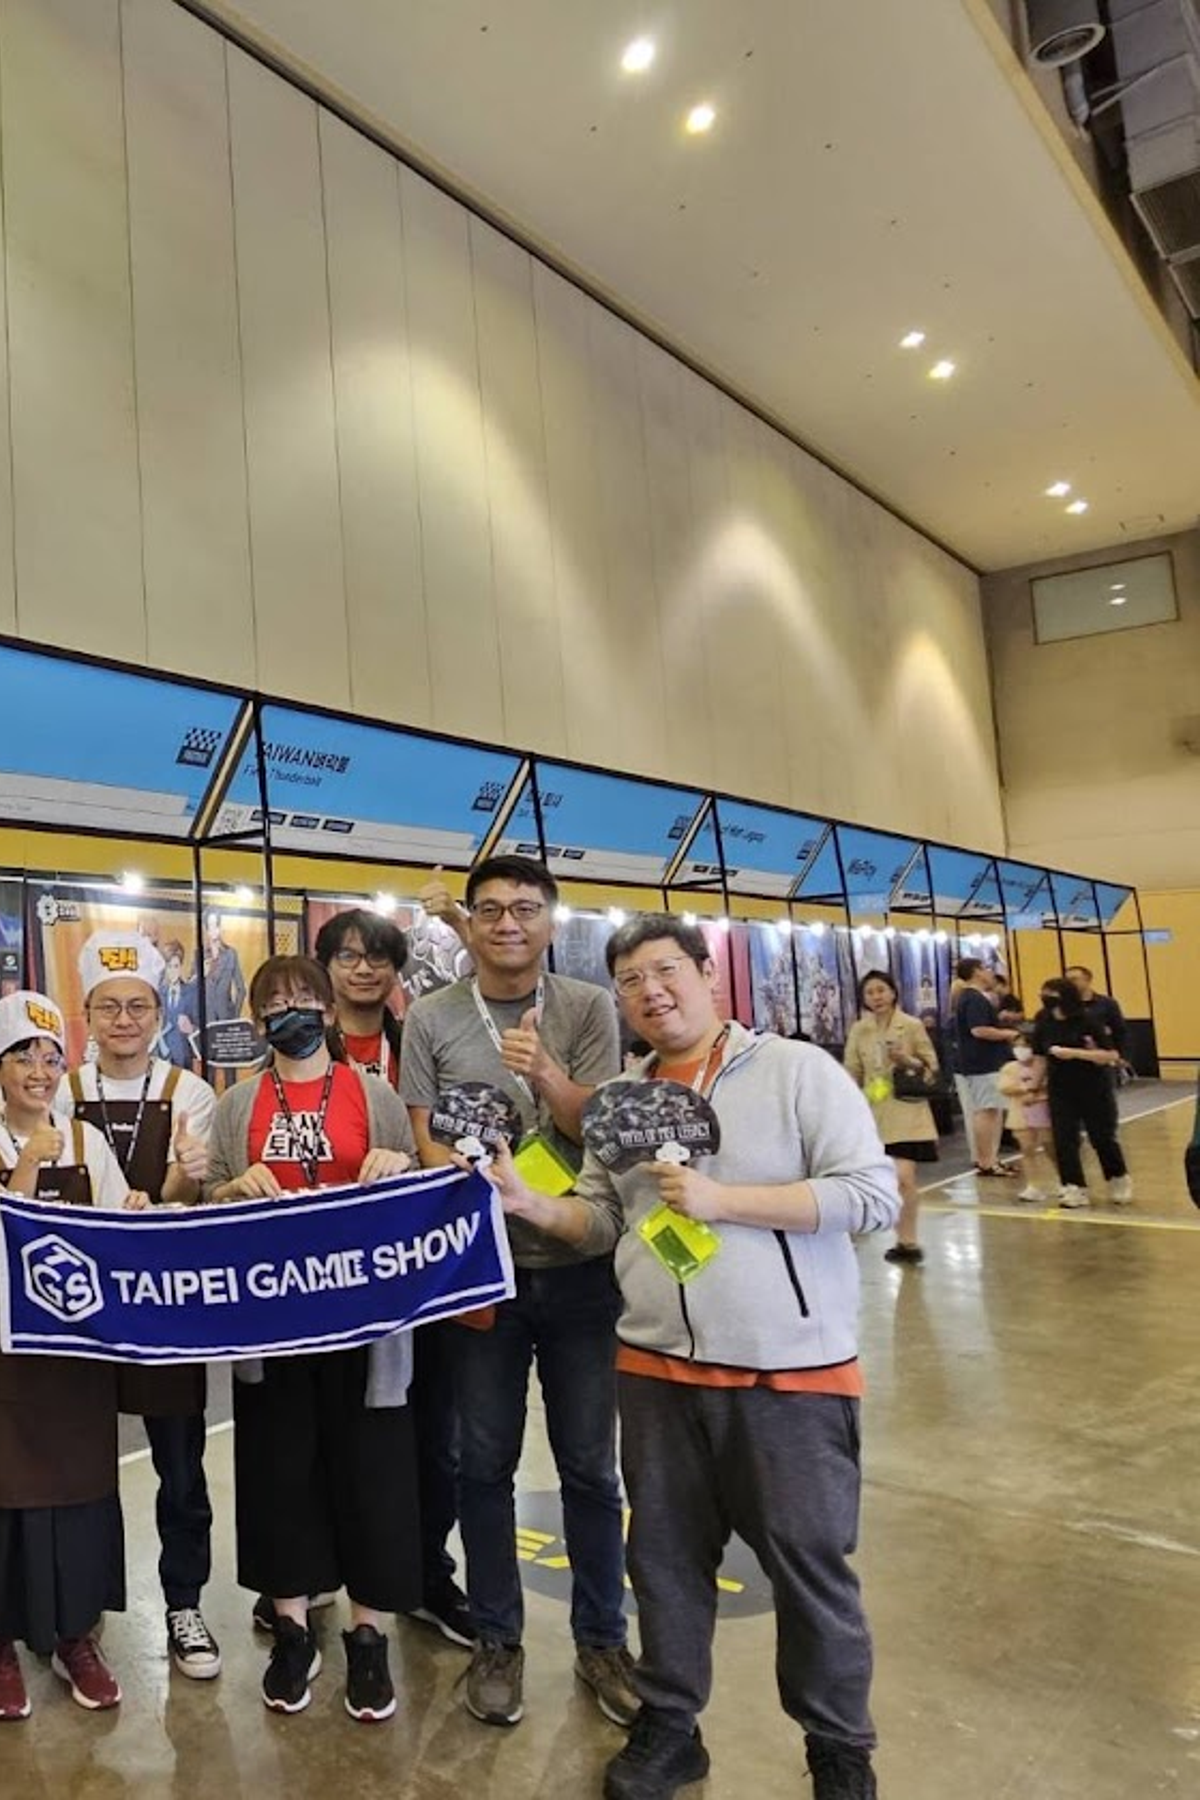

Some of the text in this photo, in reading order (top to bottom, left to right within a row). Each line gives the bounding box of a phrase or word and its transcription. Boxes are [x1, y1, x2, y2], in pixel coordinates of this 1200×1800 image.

[110, 1210, 481, 1306] TAIPEI GAME SHOW
